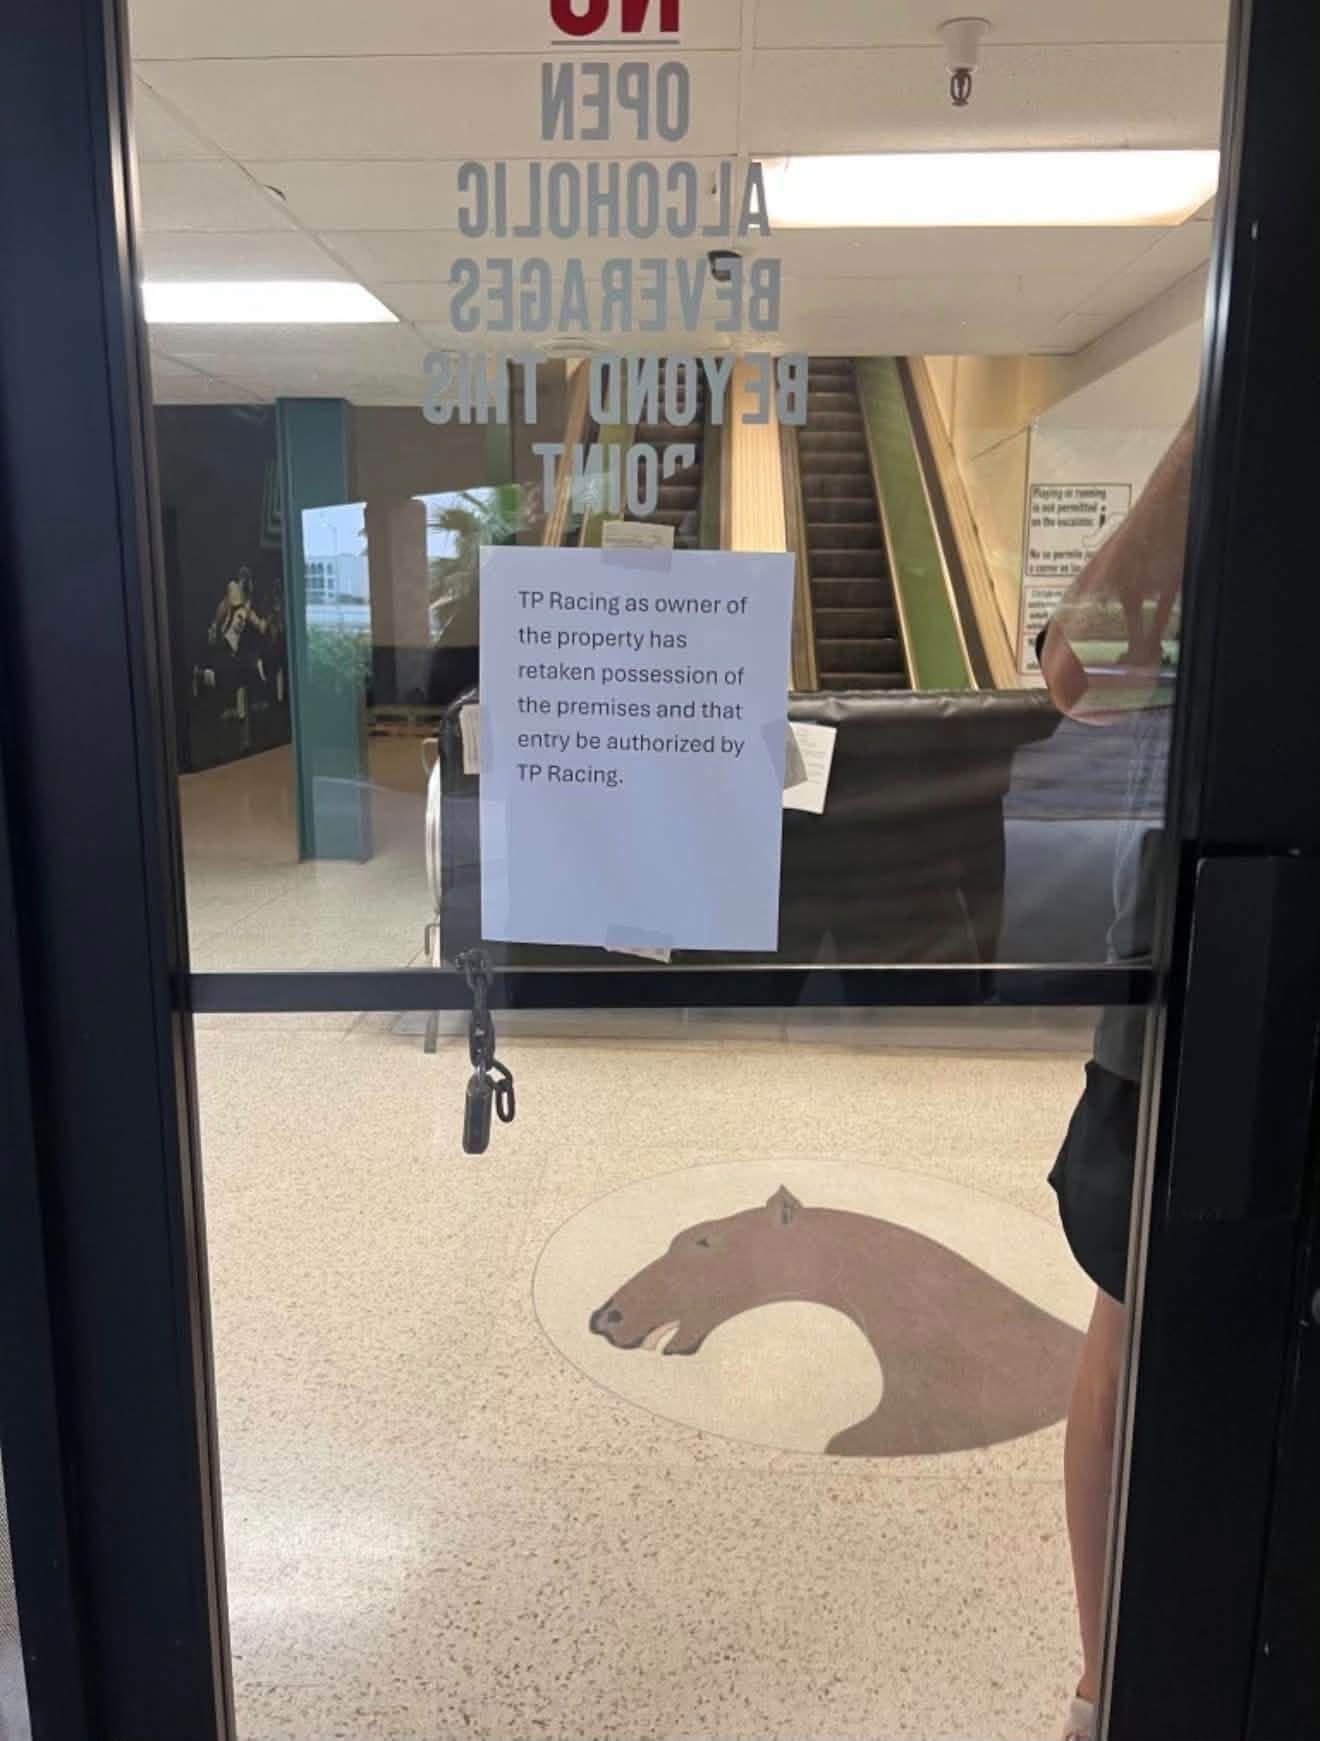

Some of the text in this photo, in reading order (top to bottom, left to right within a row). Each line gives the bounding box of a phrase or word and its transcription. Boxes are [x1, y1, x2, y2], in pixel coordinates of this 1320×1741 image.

[1075, 489, 1106, 500] running
[1056, 502, 1097, 514] permitted
[518, 591, 749, 616] TP Racing as owner of
[519, 625, 688, 652] the property has
[518, 661, 745, 686] retaken possession of
[518, 696, 744, 721] the premises and that
[518, 730, 745, 758] entry be authorized by
[517, 763, 624, 787] TP Racing.
